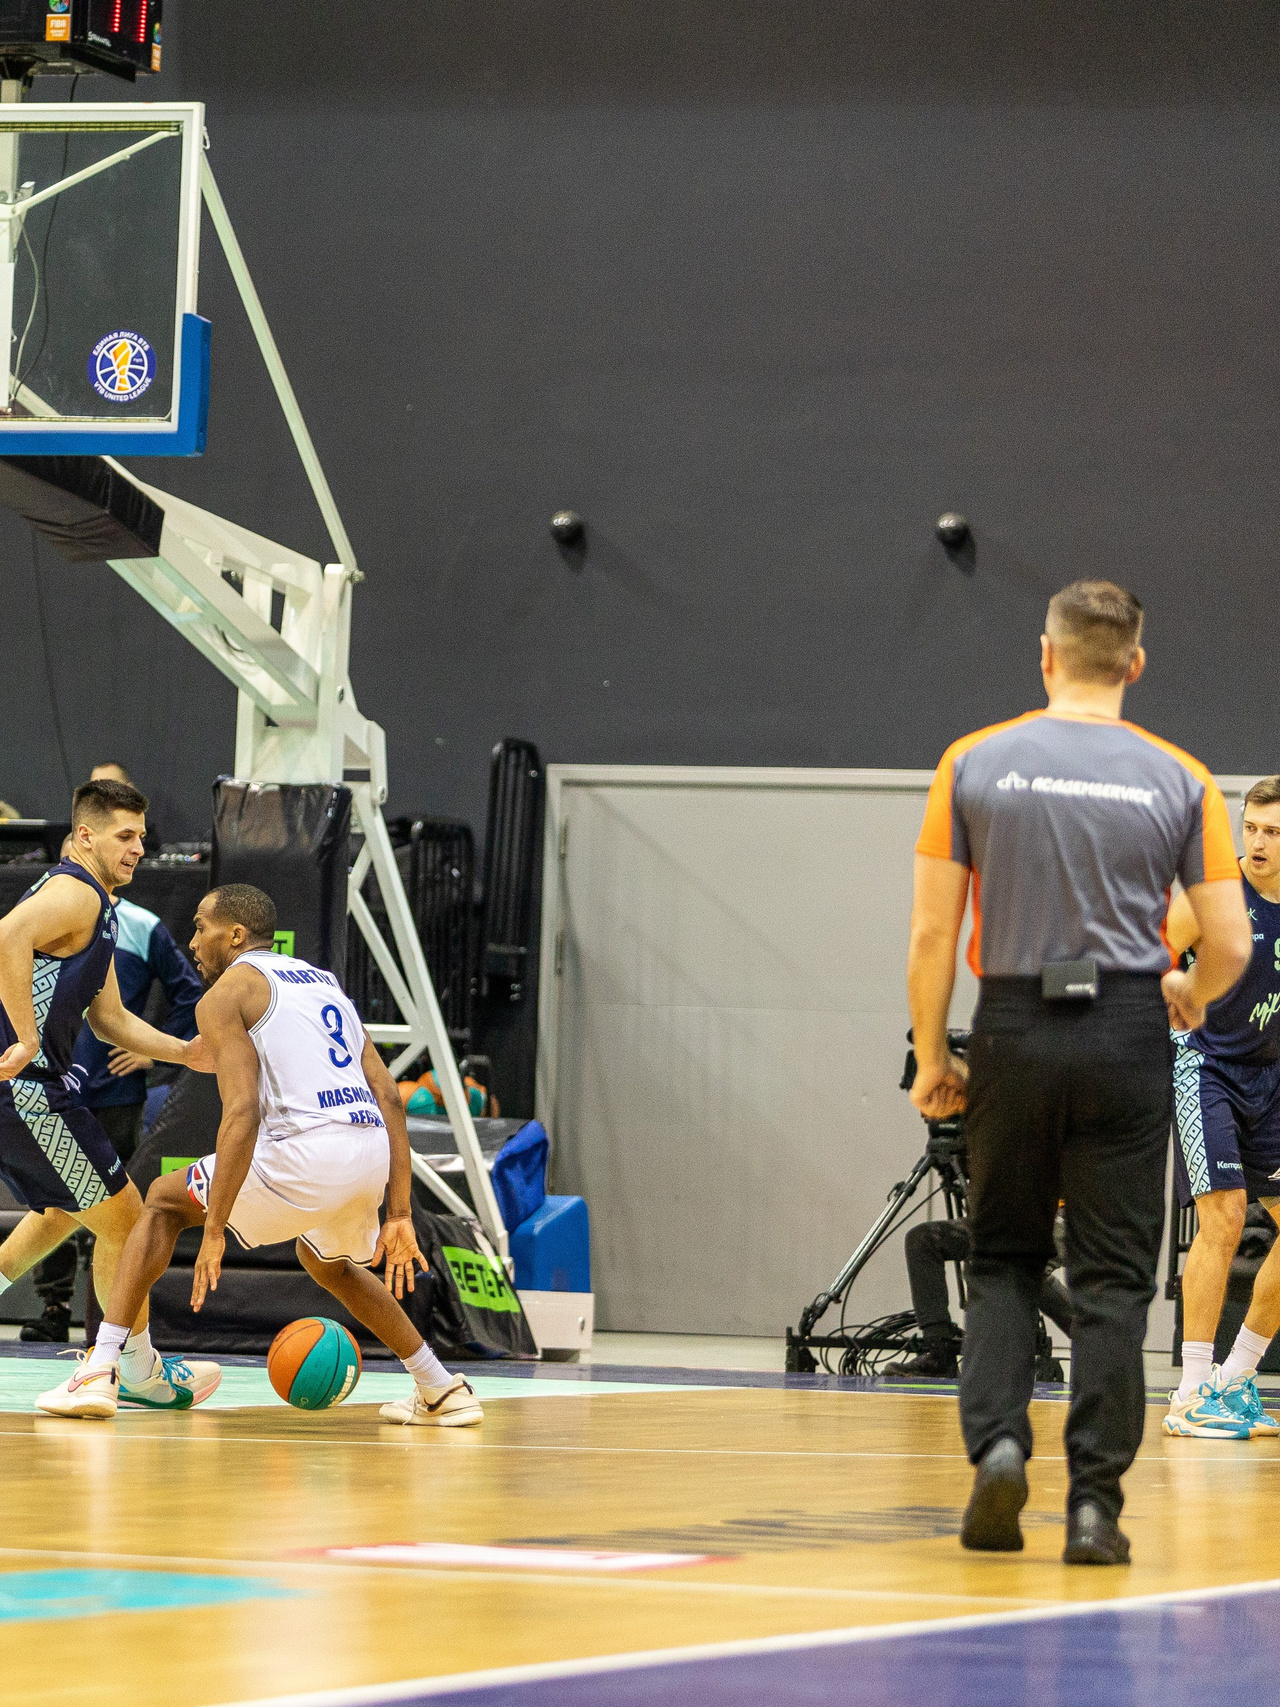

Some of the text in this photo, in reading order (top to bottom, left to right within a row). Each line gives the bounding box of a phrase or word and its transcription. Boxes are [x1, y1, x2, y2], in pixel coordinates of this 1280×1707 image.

[92, 332, 119, 356] ЕДИНАЯ
[119, 331, 138, 341] ЛИГА
[93, 376, 152, 402] VTB UNITED LEAGUE
[320, 1004, 353, 1068] 3
